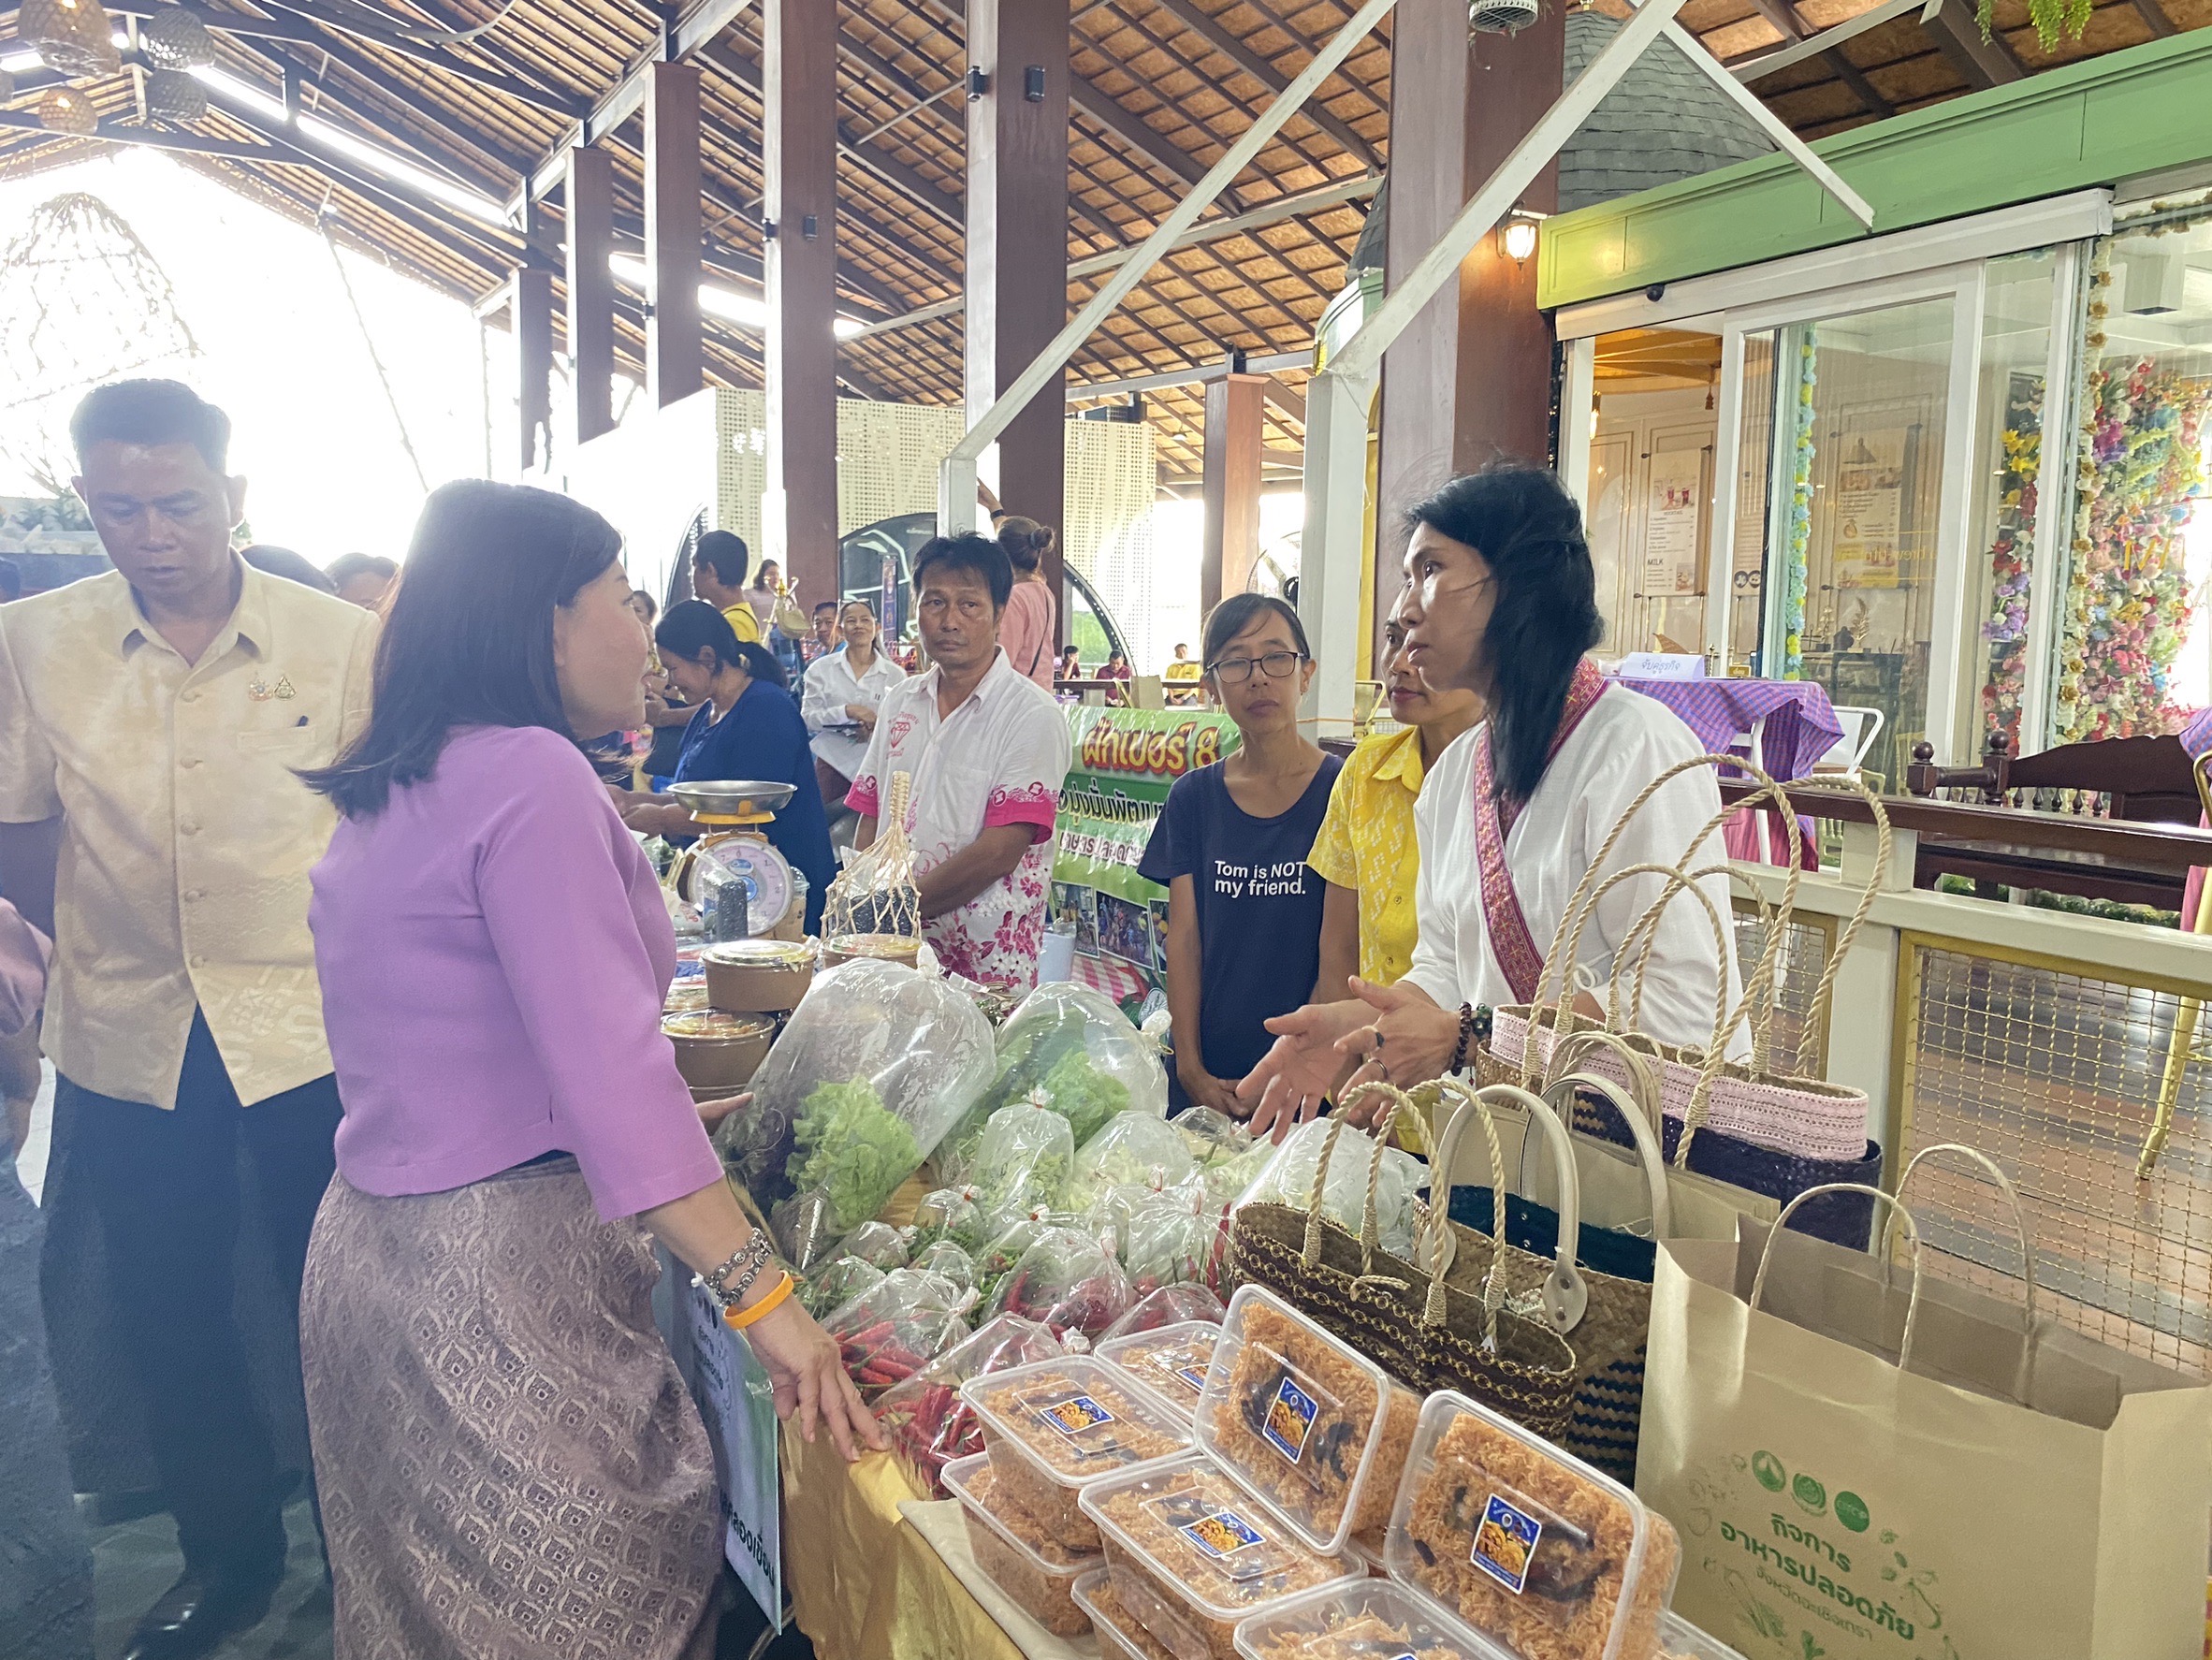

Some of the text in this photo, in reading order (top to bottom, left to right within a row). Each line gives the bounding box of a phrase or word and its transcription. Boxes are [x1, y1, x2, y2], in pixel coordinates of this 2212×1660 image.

[1641, 659, 1681, 675] จับคู่ธุรกิจ
[1194, 726, 1219, 768] 8
[1215, 860, 1307, 879] Tom is NOT
[1215, 877, 1306, 898] my friend.
[1770, 1512, 1852, 1573] กิจการ
[1720, 1521, 1915, 1641] อาหารปลอดภัย
